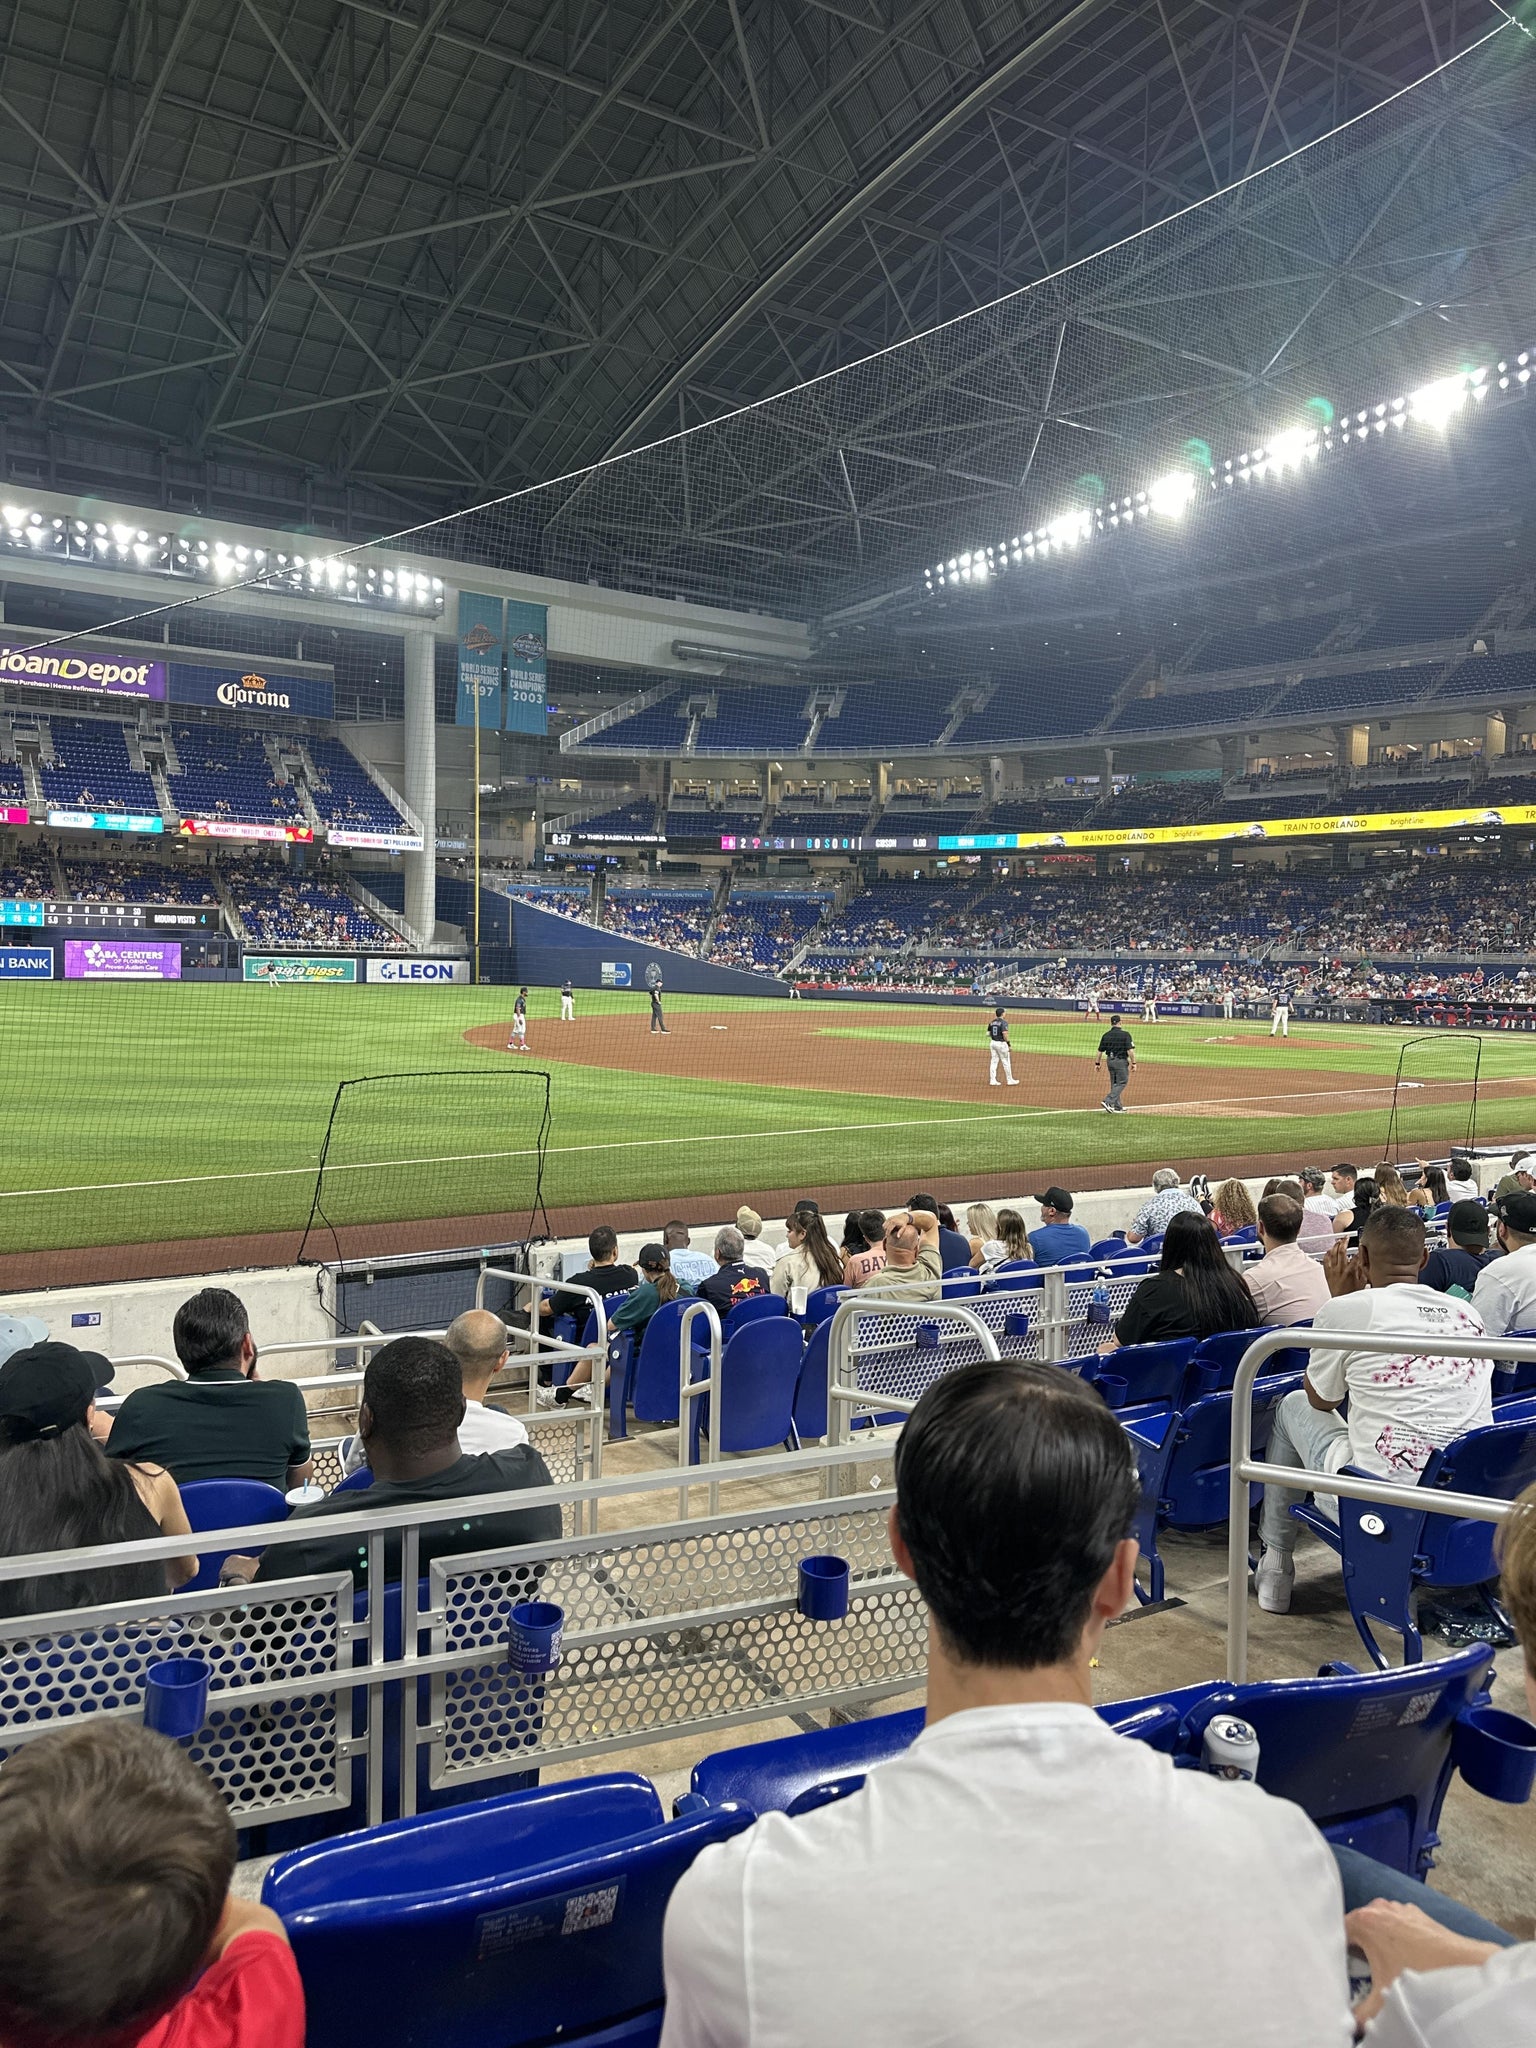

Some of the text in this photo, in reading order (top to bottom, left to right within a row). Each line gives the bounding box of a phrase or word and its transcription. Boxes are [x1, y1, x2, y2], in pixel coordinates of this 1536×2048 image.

[0, 649, 149, 686] loanDepot
[460, 662, 499, 676] WORLD SERIES
[460, 672, 499, 686] CHAMPIONS
[510, 669, 546, 683] WORLD SERIES
[19, 680, 50, 688] Purchase
[72, 684, 104, 694] Refinance
[510, 679, 546, 693] CHAMPIONS
[107, 688, 150, 698] loanDepot.com
[216, 682, 290, 708] Corona
[464, 684, 494, 697] 1997
[512, 690, 544, 704] 2003
[1284, 820, 1368, 832] TRAIN TO ORLANDO
[1390, 816, 1425, 828] brightline
[824, 838, 830, 848] S
[876, 838, 926, 848] GIBSON 0.00
[1082, 834, 1104, 842] TRAIN
[1116, 832, 1155, 840] ORLANDO
[740, 838, 746, 849] 2
[84, 906, 90, 914] R
[100, 906, 108, 914] ER
[48, 916, 58, 924] 5.0
[67, 916, 72, 925] 3
[154, 914, 206, 924] MOUND VISITS 4
[98, 950, 164, 960] ABA CENTERS
[9, 958, 48, 969] BANK
[275, 966, 306, 978] Baja
[305, 966, 345, 976] Blast
[398, 964, 453, 979] LEON
[860, 1256, 888, 1274] BAY
[1416, 1306, 1448, 1314] TOKYO
[1367, 1518, 1376, 1530] C
